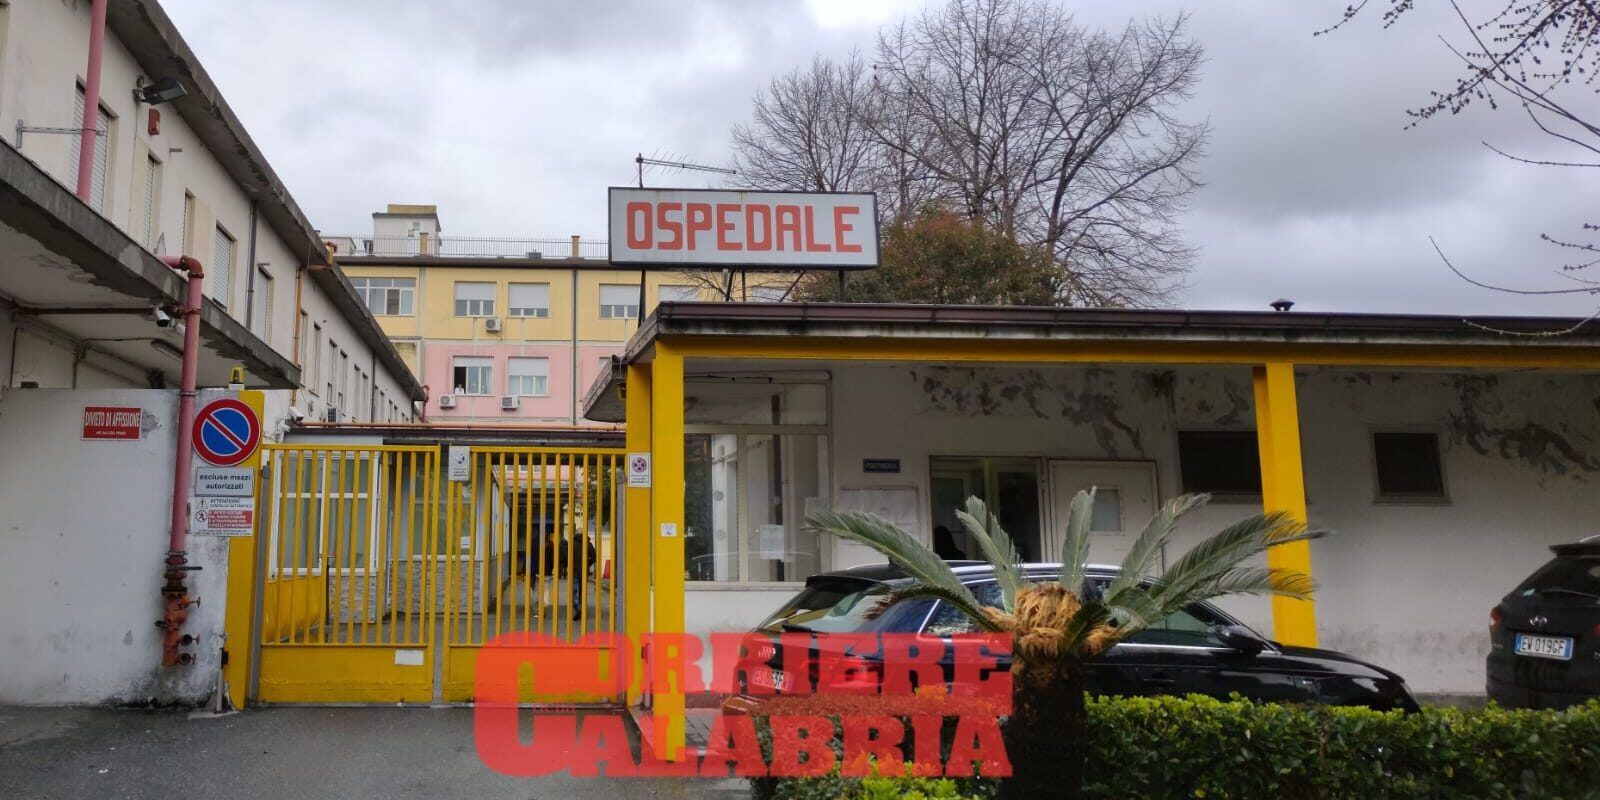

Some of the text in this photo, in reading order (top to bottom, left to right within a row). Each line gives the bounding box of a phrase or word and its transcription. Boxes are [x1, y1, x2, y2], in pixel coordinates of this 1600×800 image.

[626, 202, 862, 253] OSPEDALE
[85, 411, 141, 427] DIVIETO DI AFFISSIONE
[1522, 636, 1566, 653] EW 019GF
